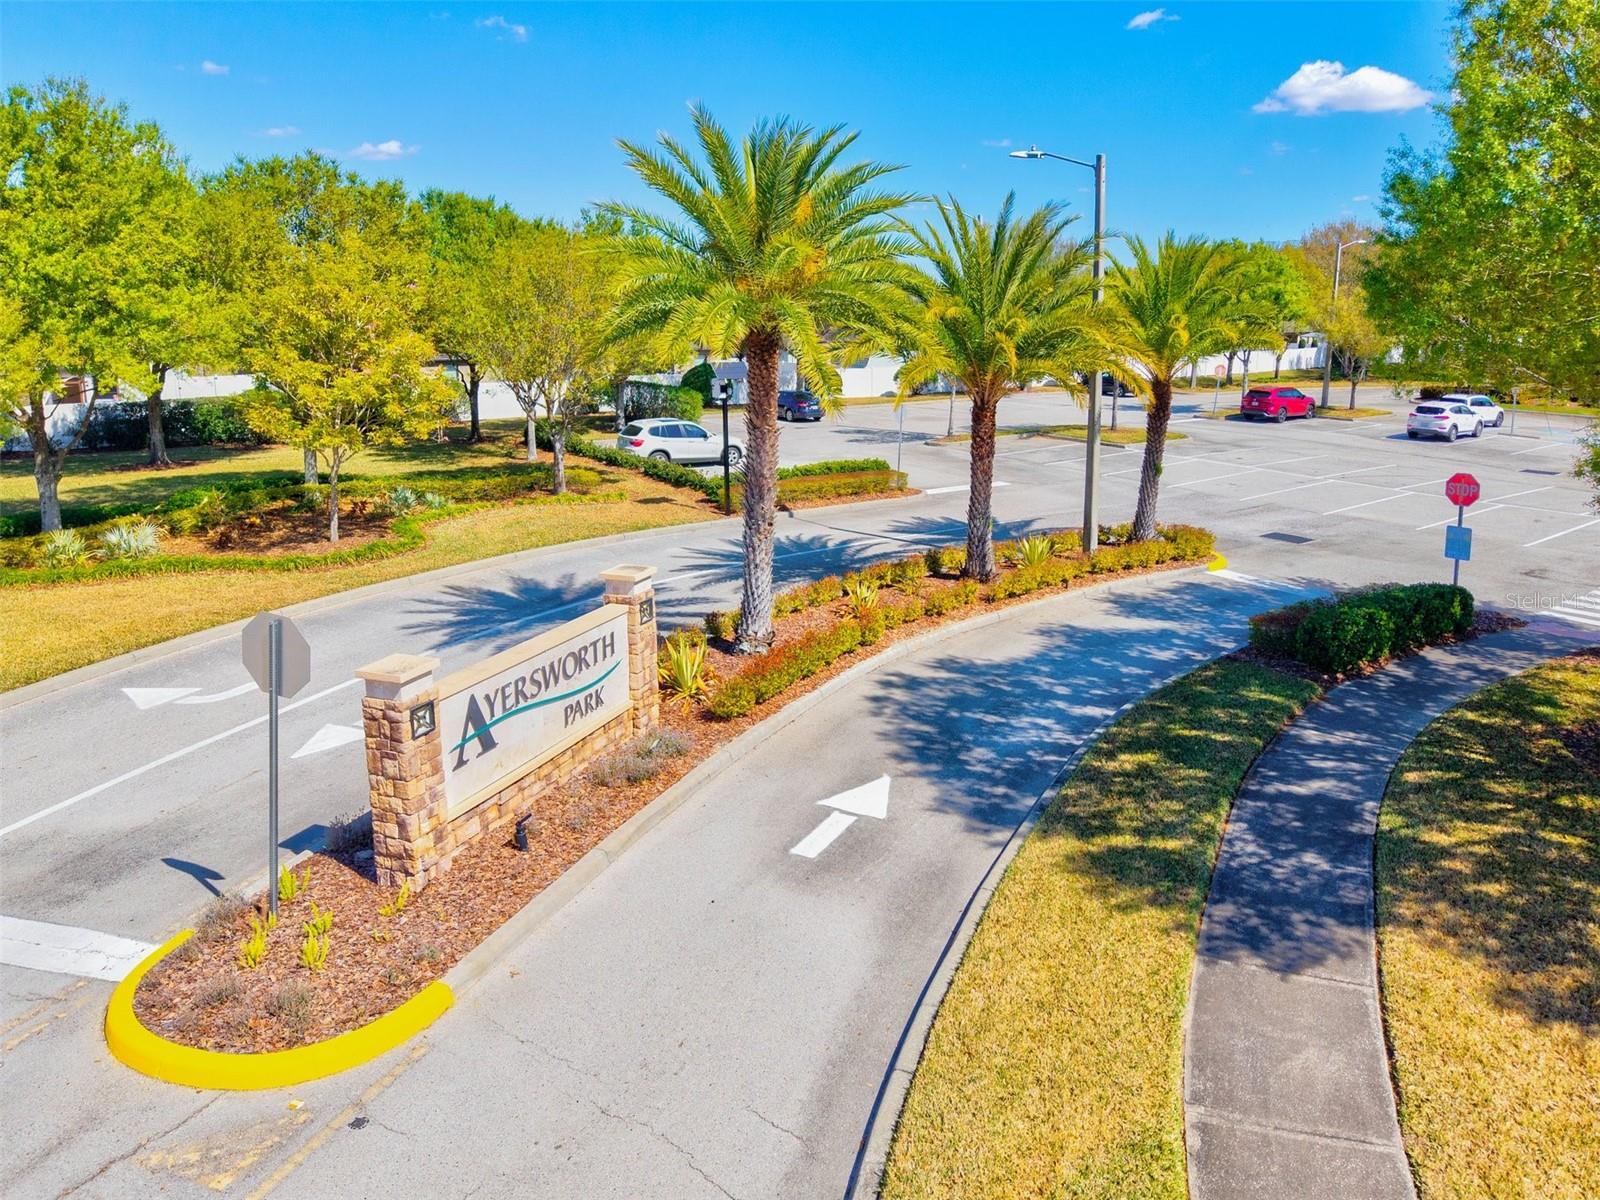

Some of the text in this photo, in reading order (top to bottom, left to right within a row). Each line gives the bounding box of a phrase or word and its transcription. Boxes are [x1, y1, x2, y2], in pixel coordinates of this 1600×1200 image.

[1448, 483, 1478, 497] STOP
[452, 631, 615, 772] AYERSWORTH
[563, 685, 605, 728] PARK
